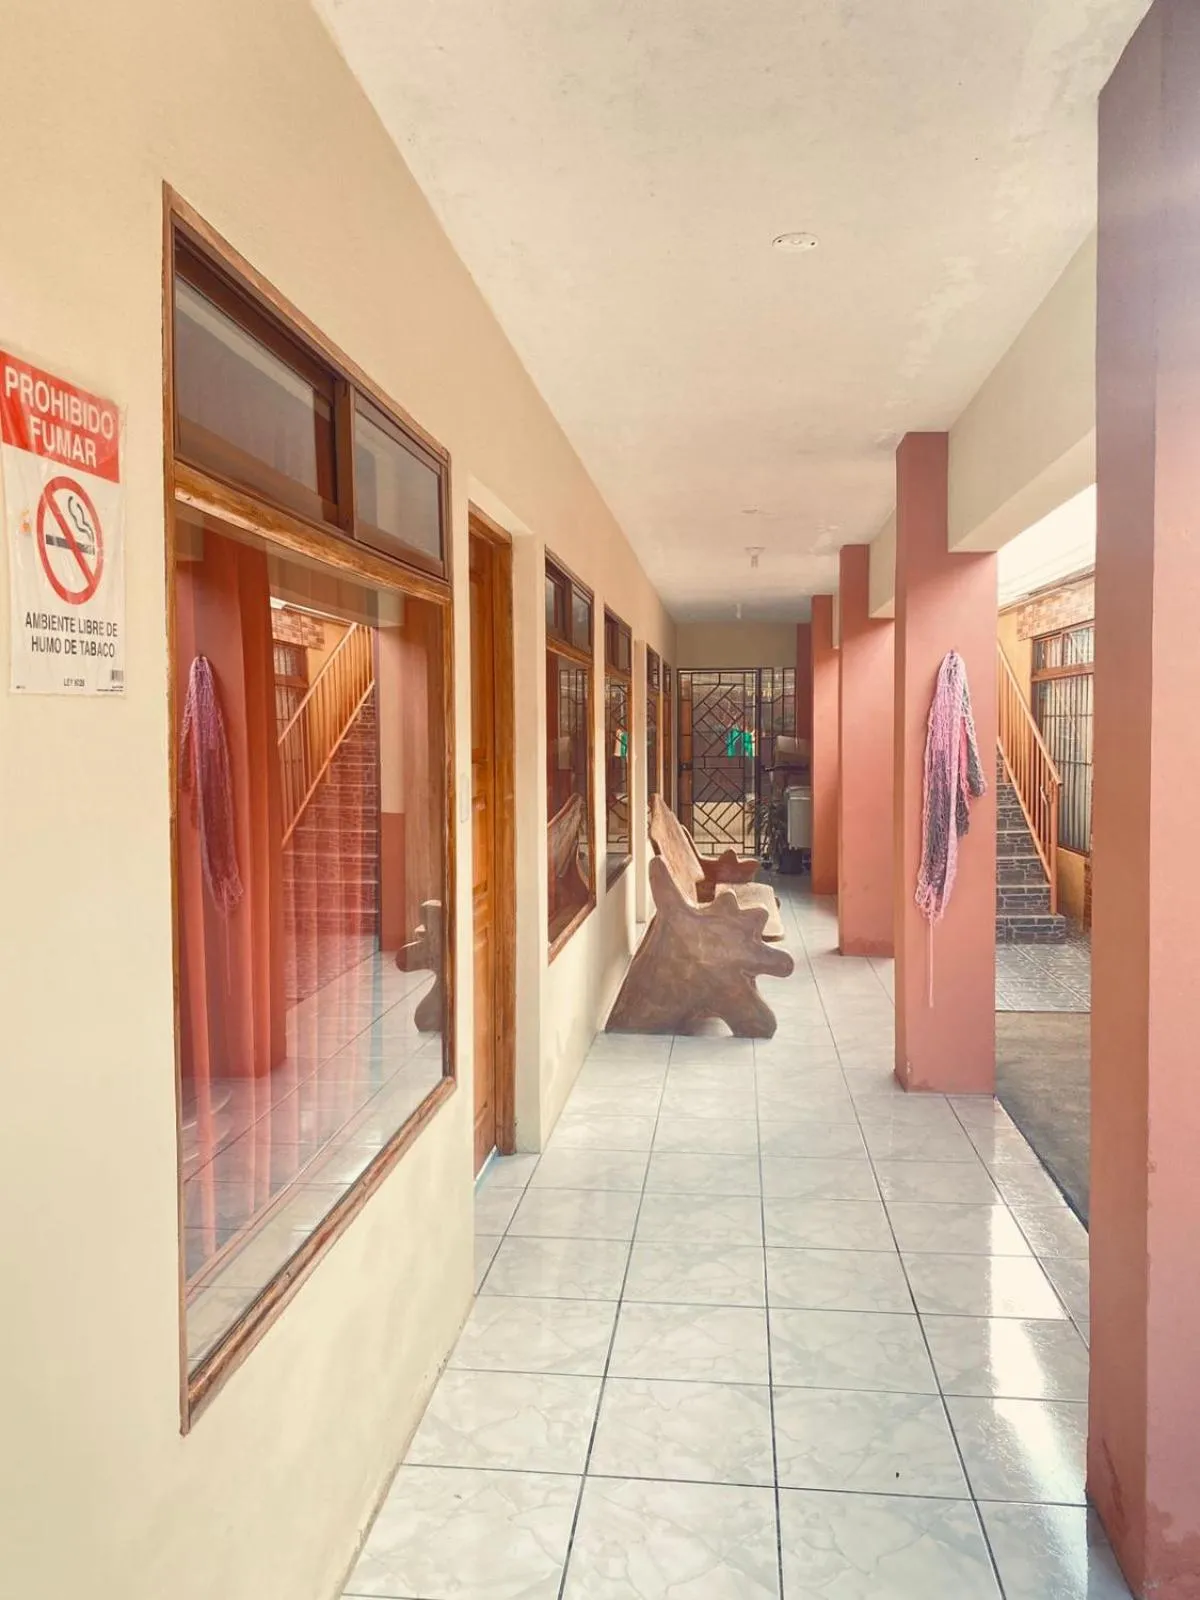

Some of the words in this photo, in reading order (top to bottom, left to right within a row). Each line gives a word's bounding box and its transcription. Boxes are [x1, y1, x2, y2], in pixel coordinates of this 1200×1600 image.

[5, 365, 114, 440] PROHIBIDO
[29, 414, 97, 468] FUMAR
[25, 611, 76, 633] AMBIENTE
[78, 618, 104, 636] LIBRE
[106, 622, 118, 637] DE
[31, 635, 61, 654] HUMO
[64, 638, 77, 655] DE
[79, 640, 115, 658] TABACO
